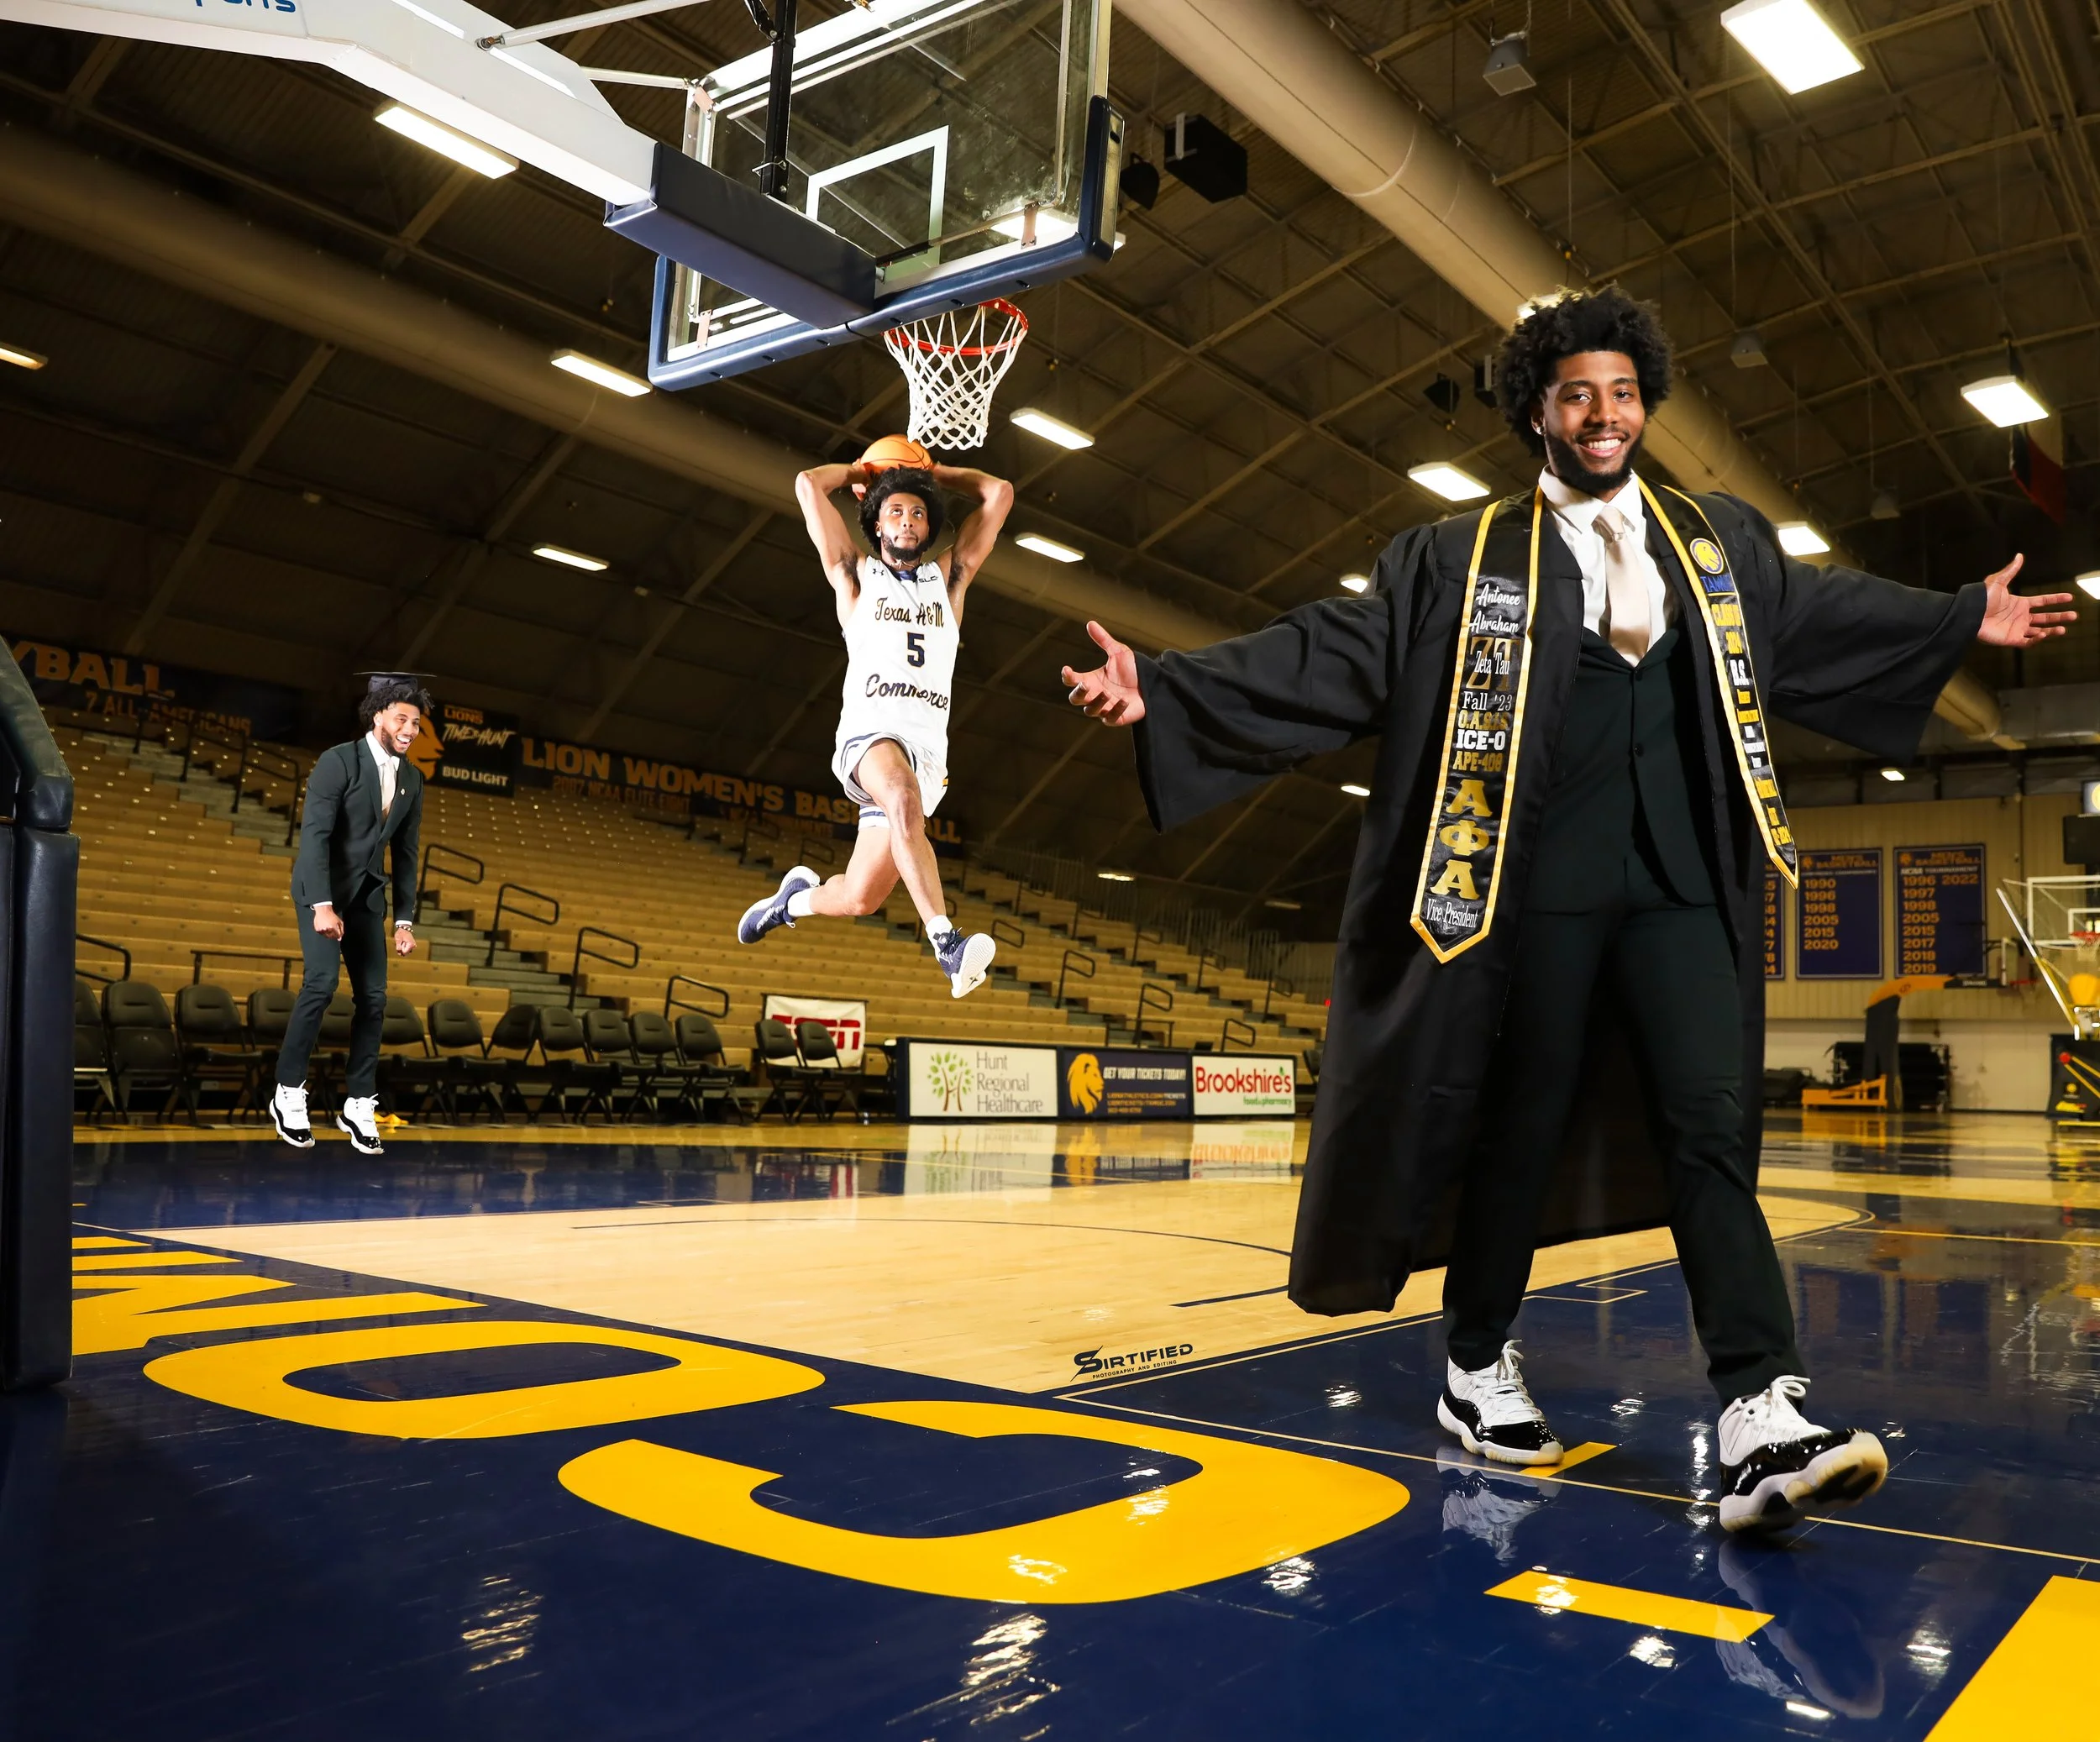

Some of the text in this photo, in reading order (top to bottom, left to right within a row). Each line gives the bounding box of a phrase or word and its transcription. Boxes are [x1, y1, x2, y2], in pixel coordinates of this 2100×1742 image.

[1476, 584, 1520, 606] Antonee
[875, 597, 944, 628] Texas A&M
[1468, 611, 1519, 633] Abraham
[907, 632, 925, 668] 5
[1474, 650, 1510, 675] Zeta Tau
[1462, 691, 1513, 711] Fall '23
[442, 723, 474, 742] TIME
[475, 727, 517, 750] HUNT
[443, 765, 508, 786] BUD LIGHT
[521, 737, 611, 780] LION
[623, 757, 784, 812] WOMEN'S
[1804, 879, 1836, 889] 1990
[1903, 874, 1978, 886] 1996 2022
[1804, 890, 1836, 901] 1996
[1903, 887, 1935, 899] 1997
[1426, 898, 1478, 928] Vice President
[1804, 915, 1840, 926] 2005
[1903, 912, 1940, 924] 2005
[1804, 927, 1835, 937] 2015
[1903, 925, 1935, 936] 2015
[1804, 939, 1840, 950] 2020
[1903, 937, 1935, 948] 2017
[976, 1051, 1008, 1071] Hunt
[977, 1073, 1029, 1098] Regional
[1195, 1066, 1292, 1094] Brookshire's
[977, 1093, 1043, 1113] Healthcare
